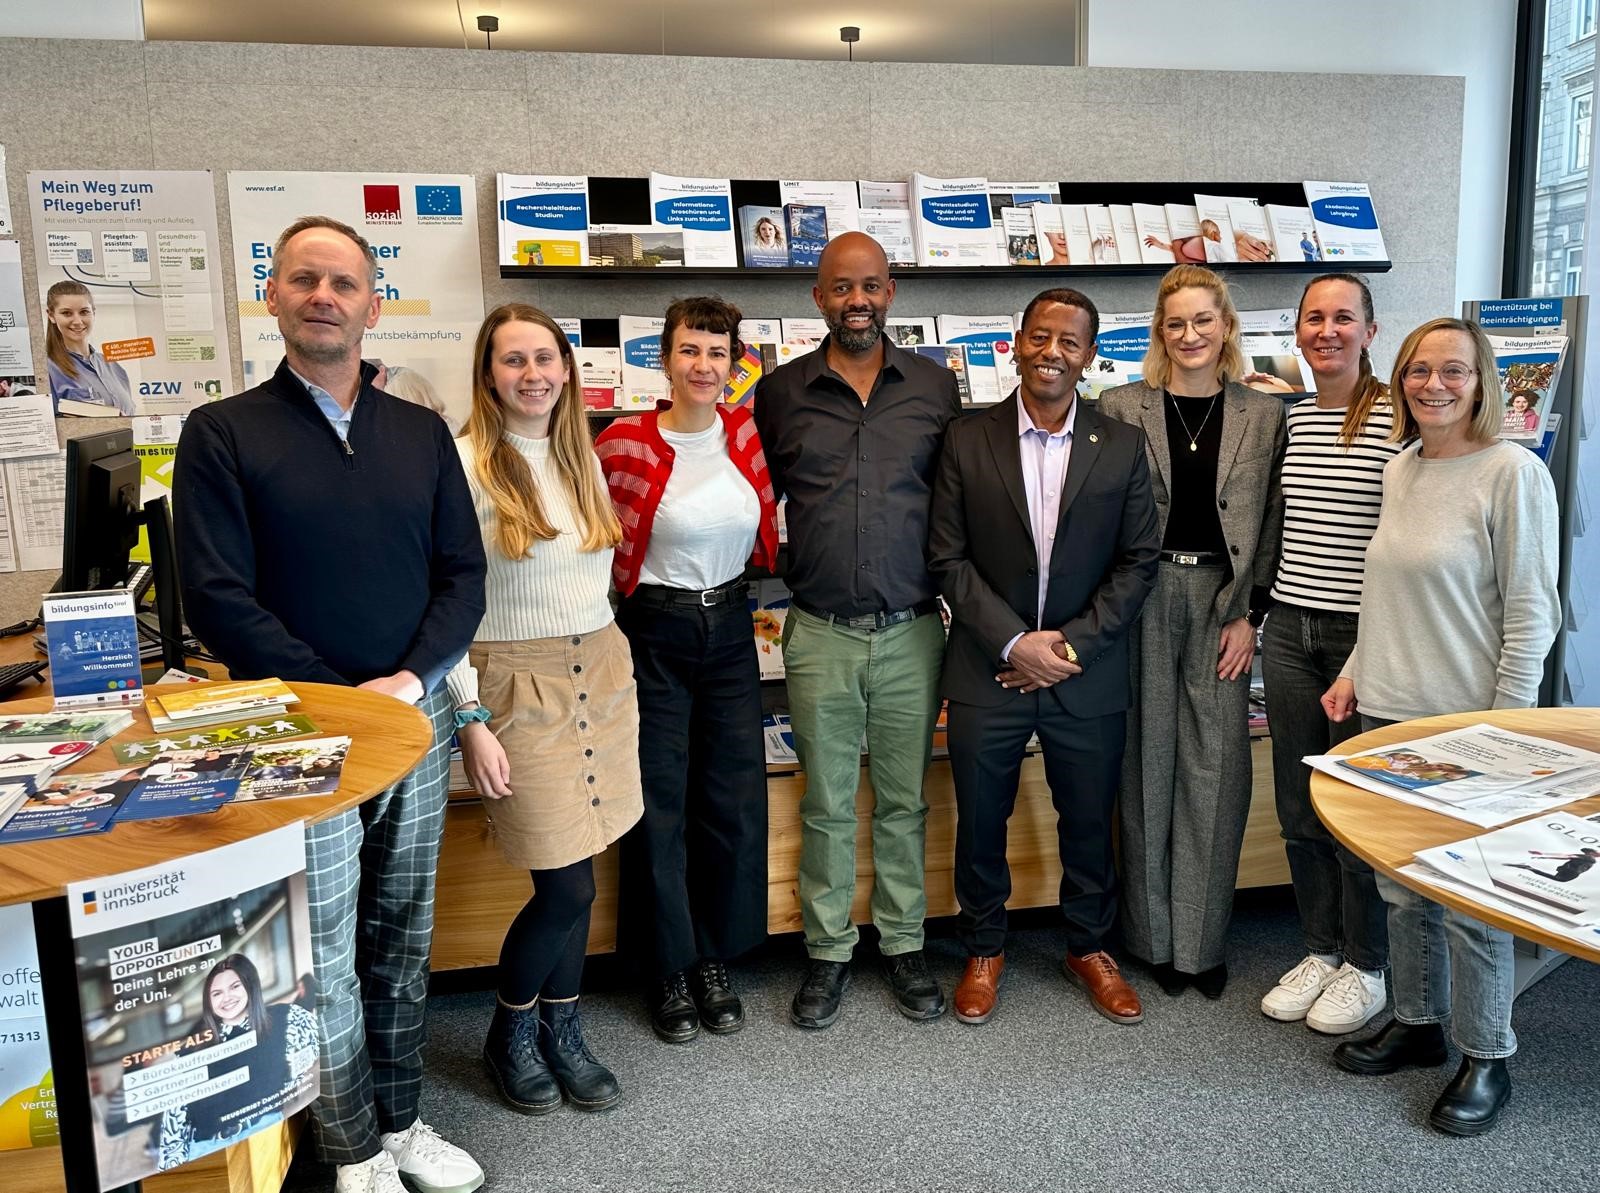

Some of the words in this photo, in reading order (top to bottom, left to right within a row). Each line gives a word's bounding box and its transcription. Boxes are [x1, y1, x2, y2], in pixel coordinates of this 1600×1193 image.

[42, 181, 78, 194] Mein
[83, 181, 116, 196] Weg
[120, 183, 153, 194] zum
[245, 185, 285, 193] www.esf.at
[44, 199, 142, 214] Pflegeberuf!
[125, 217, 152, 225] Einstieg
[166, 217, 194, 225] Aufstieg
[366, 209, 401, 220] sozial
[1481, 303, 1538, 311] Unterstützung
[1540, 302, 1553, 310] bei
[1480, 315, 1559, 324] Beeinträchtigungen
[365, 331, 461, 341] mutsbekämpfung
[735, 369, 750, 384] HTL
[139, 382, 181, 395] azw
[134, 448, 146, 456] nn
[161, 447, 176, 455] tro
[51, 602, 114, 613] bildungsinfo
[83, 662, 134, 671] Willkommen!
[145, 779, 219, 789] bildungsinfo
[15, 807, 94, 820] bildungsinfo
[1547, 822, 1600, 847] GLO
[103, 870, 186, 899] universität
[104, 885, 179, 911] innsbruck
[114, 941, 154, 960] YOUR
[115, 938, 218, 977] OPPORTUNITY.
[113, 975, 153, 995] Deine
[158, 965, 197, 984] Lehre
[200, 957, 217, 970] an
[114, 997, 138, 1013] der
[144, 986, 172, 1003] Uni.
[122, 1040, 181, 1067] STARTE
[186, 1029, 214, 1048] ALS
[144, 1071, 205, 1098] Gärtner:in
[145, 1072, 246, 1113] Labortechniker:in
[262, 1093, 280, 1104] Dann
[21, 1100, 57, 1110] Vertra
[46, 1110, 58, 1119] Re
